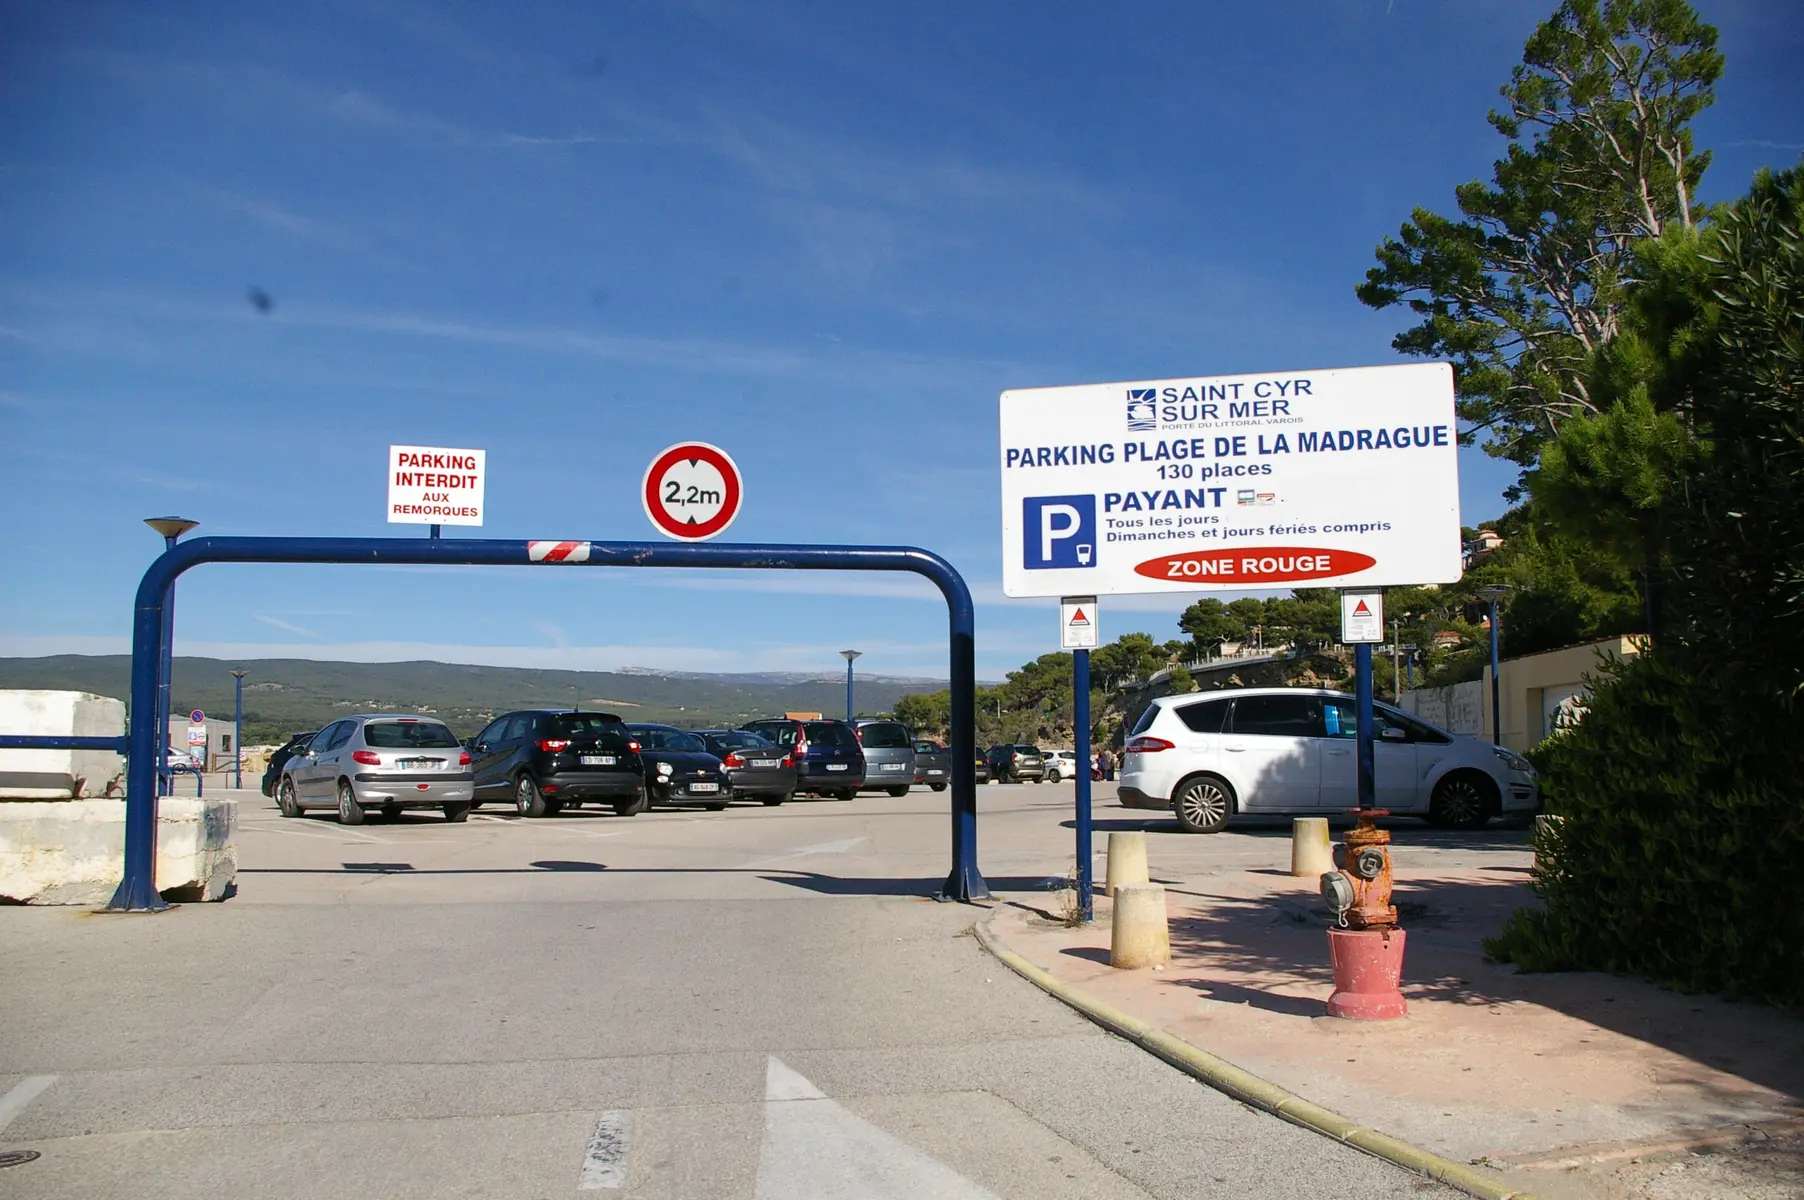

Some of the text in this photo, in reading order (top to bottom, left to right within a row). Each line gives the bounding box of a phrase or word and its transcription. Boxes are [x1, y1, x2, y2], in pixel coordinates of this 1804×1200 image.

[1162, 379, 1313, 404] SAINT CYR
[1162, 400, 1291, 422] SUR MER
[1215, 419, 1265, 428] LITTORAL
[1267, 416, 1304, 426] VAROIS
[1006, 425, 1449, 468] PARKING PLAGE DE LA MADRAGUE
[398, 453, 476, 470] PARKING
[1156, 463, 1272, 482] 130 places
[395, 472, 478, 489] INTERDIT
[422, 492, 450, 502] AUX
[665, 480, 720, 507] 2,2m
[1103, 487, 1227, 513] PAYANT
[393, 504, 478, 517] REMORQUES
[1105, 514, 1219, 529] Tous les jours
[1040, 503, 1081, 562] P
[1106, 520, 1392, 543] Dimanches et jours fériés compris
[1166, 555, 1332, 577] ZONE ROUGE
